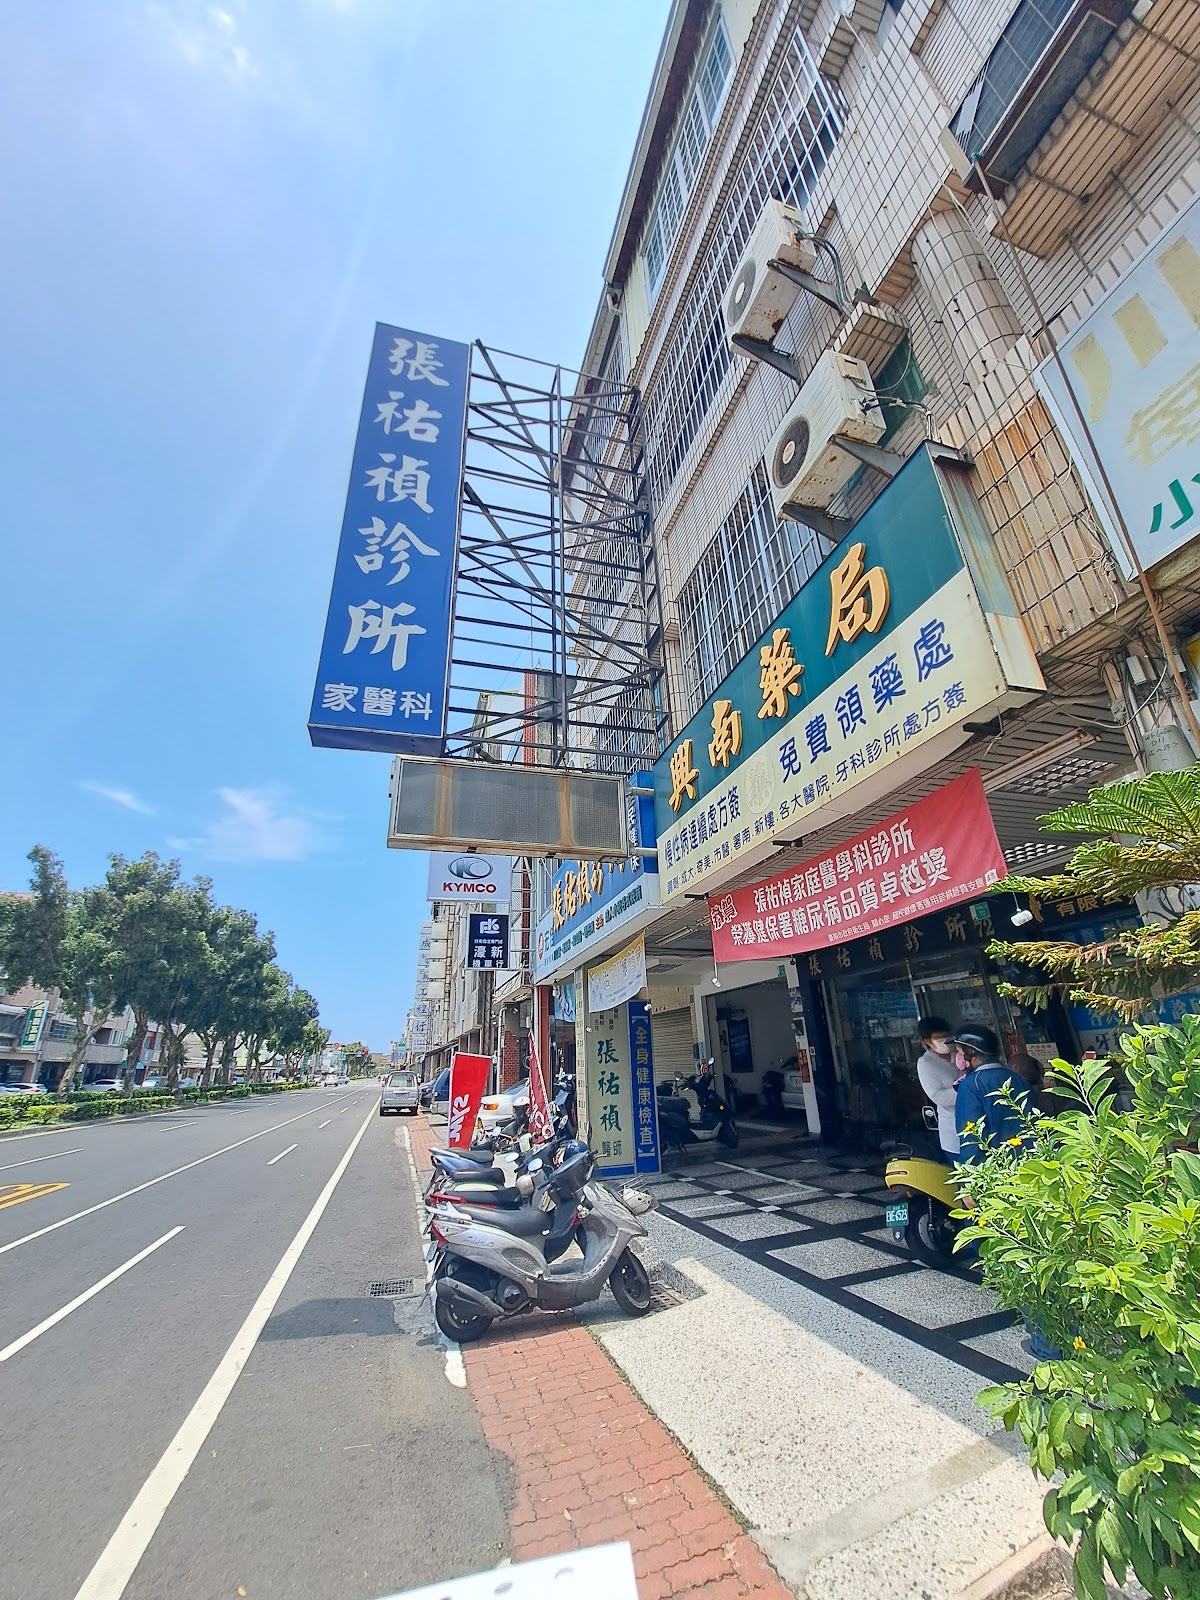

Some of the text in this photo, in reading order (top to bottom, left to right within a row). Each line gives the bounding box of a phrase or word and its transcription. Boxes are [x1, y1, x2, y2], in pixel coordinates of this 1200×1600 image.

[343, 338, 450, 672] 張祐禎診所
[321, 682, 433, 720] 家醫科
[778, 618, 954, 783] 免費領藥處
[442, 882, 497, 894] KYMCO
[731, 846, 952, 946] 榮獲健保署糖尿病品質卓越獎
[754, 817, 916, 913] 張祐禎家庭醫學科診所
[808, 912, 968, 977] 張祐禎診所
[597, 1038, 621, 1132] 張祐禎
